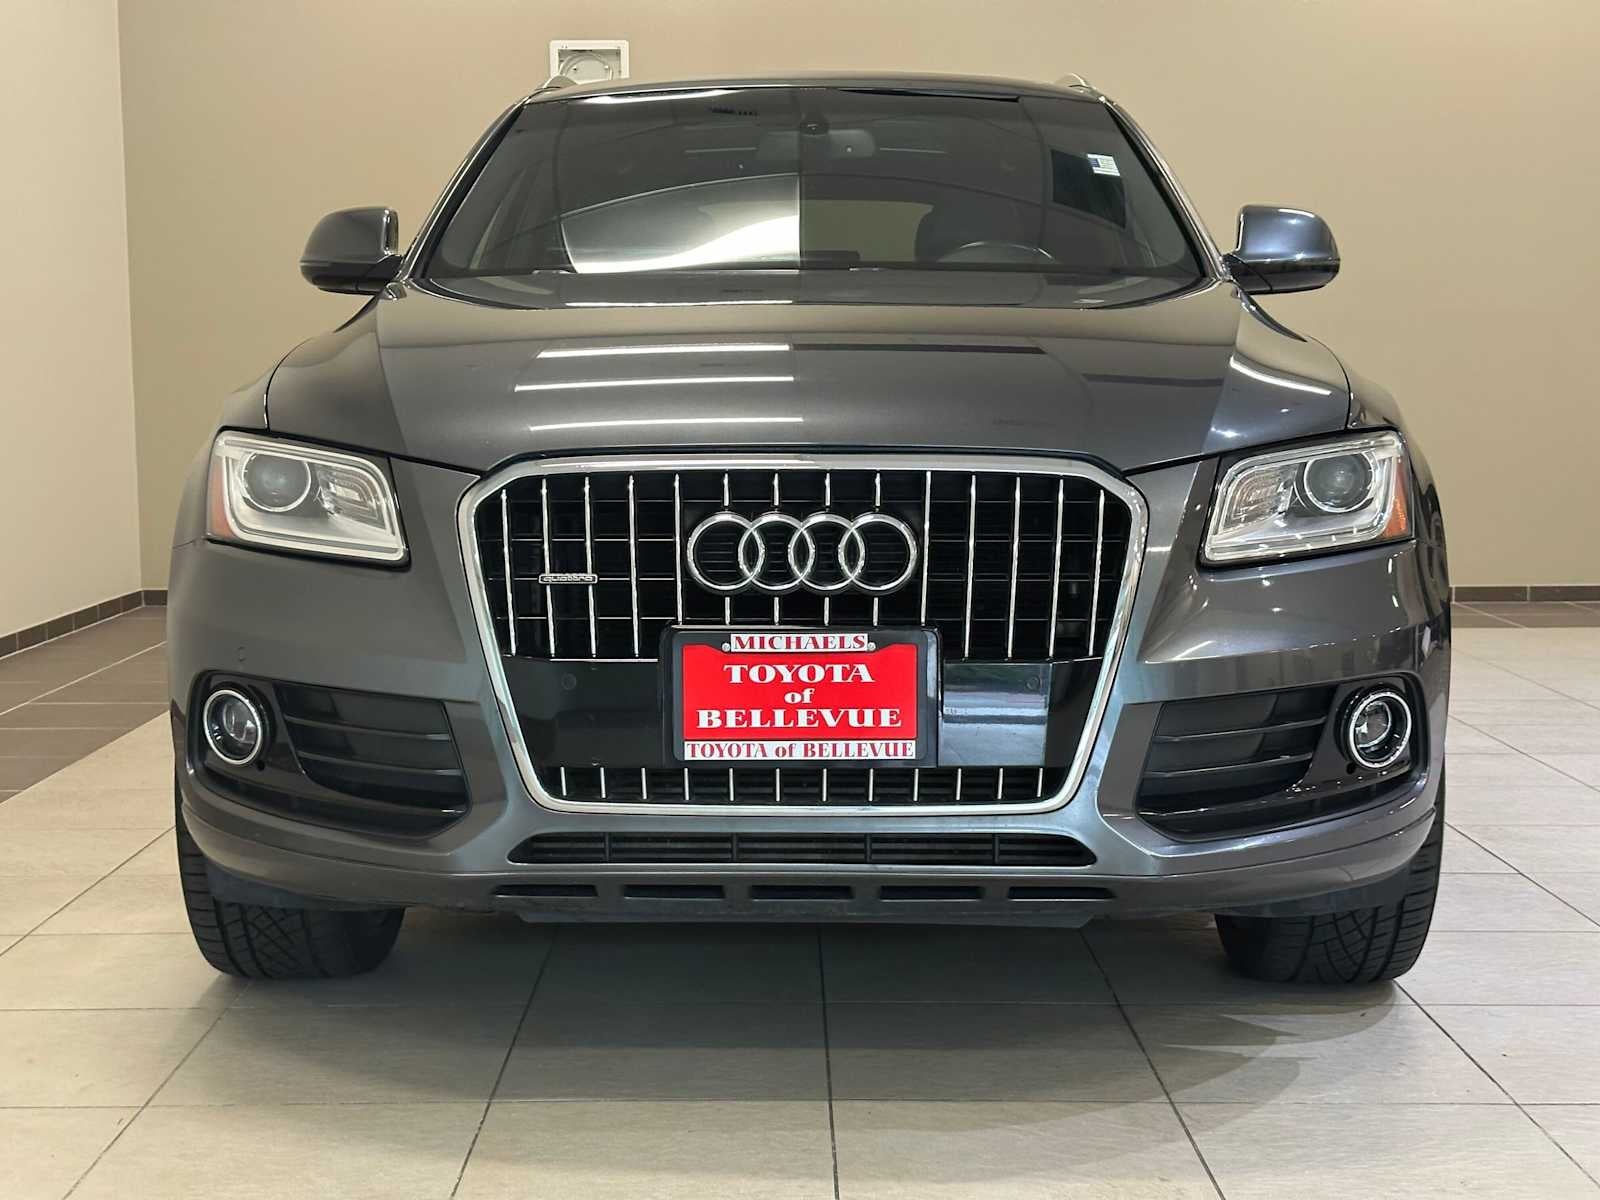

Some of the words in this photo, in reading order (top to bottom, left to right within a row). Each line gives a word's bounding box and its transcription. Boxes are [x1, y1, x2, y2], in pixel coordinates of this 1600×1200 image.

[733, 635, 866, 650] MICHAELS
[723, 664, 874, 683] TOYOTA
[784, 688, 815, 704] of
[696, 708, 902, 729] BELLEVUE
[687, 742, 768, 758] TOYOTA
[774, 742, 797, 758] of
[803, 742, 915, 758] BELLEVUE
